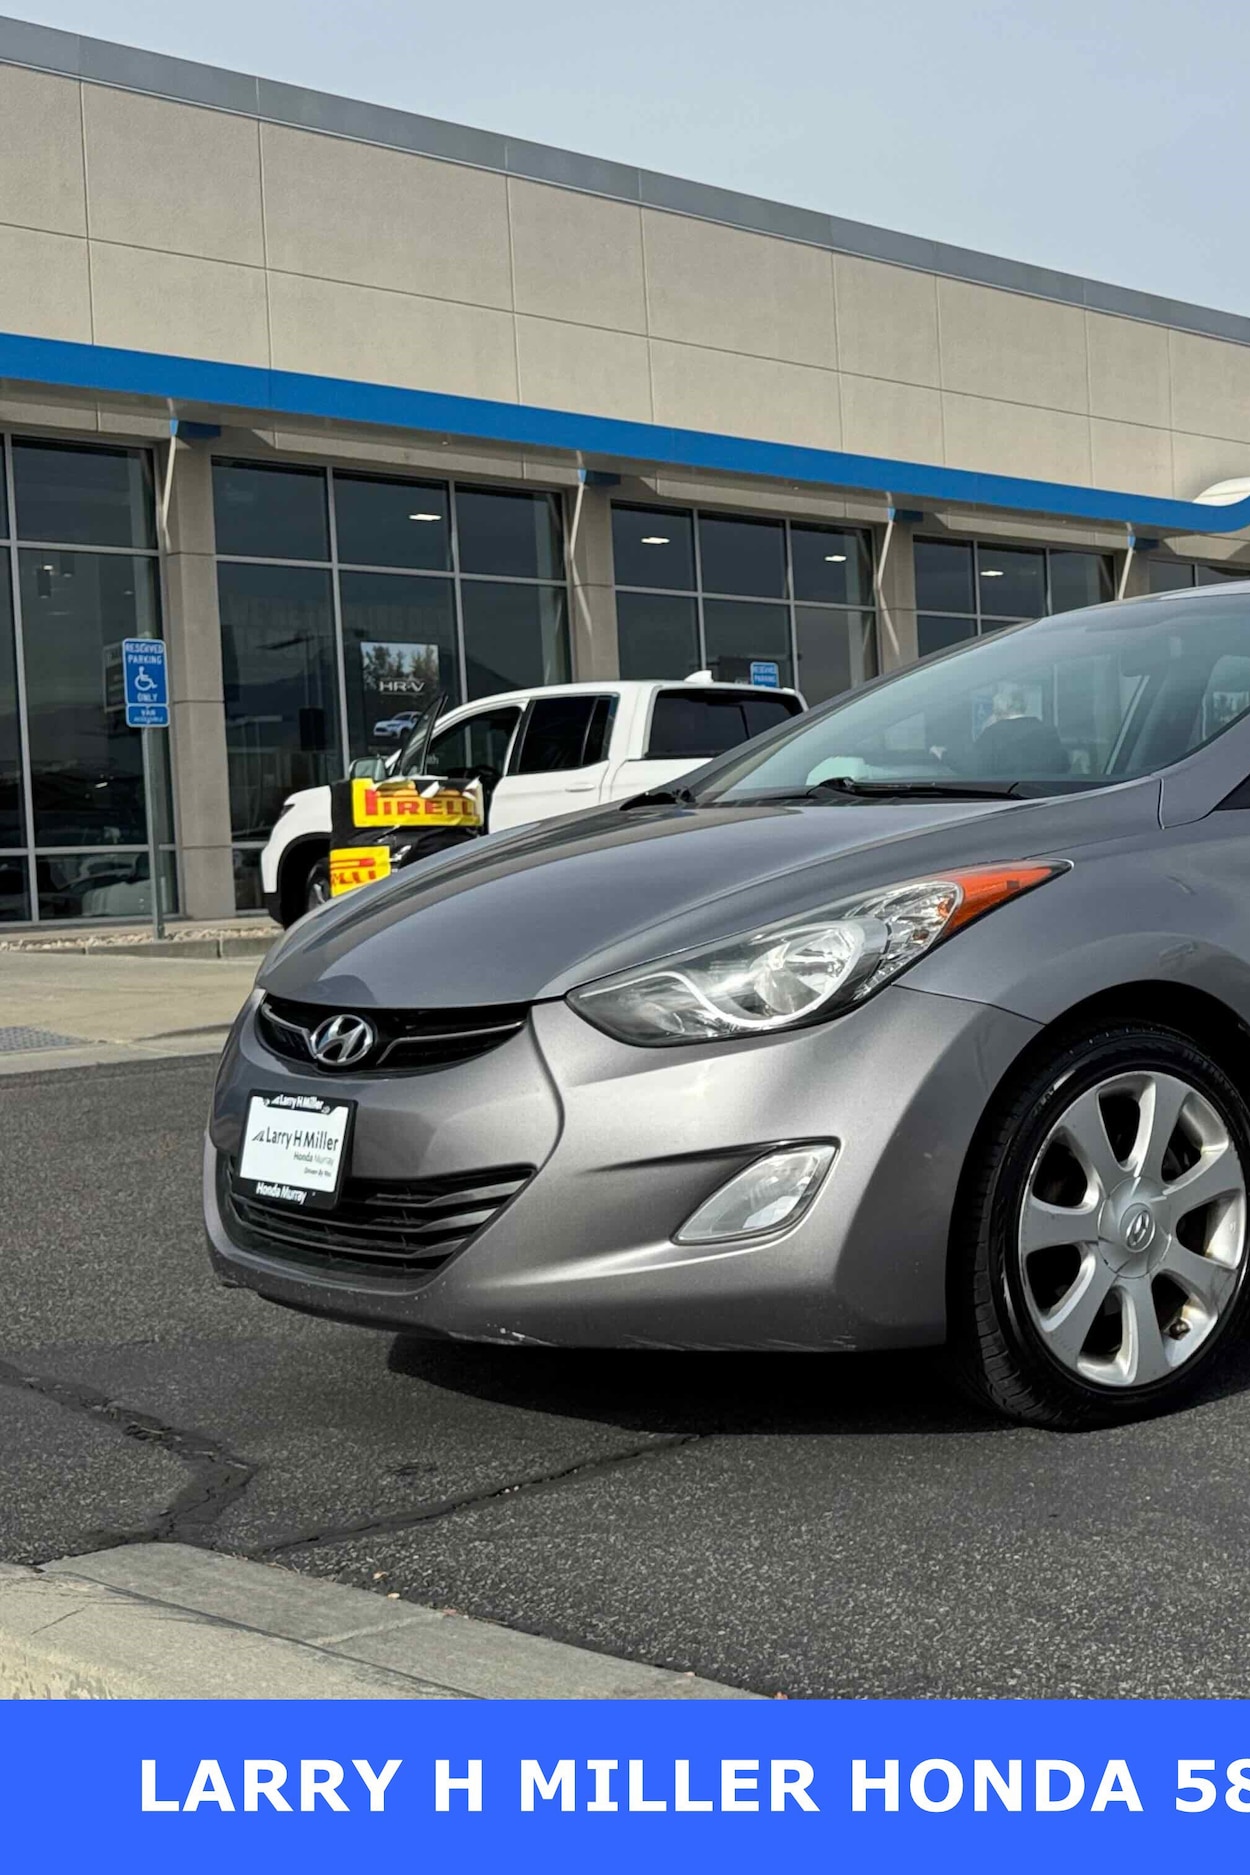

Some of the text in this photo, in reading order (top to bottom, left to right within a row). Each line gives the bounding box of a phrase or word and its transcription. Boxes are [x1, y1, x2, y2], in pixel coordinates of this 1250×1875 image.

[125, 643, 164, 653] RESERVED
[127, 654, 162, 665] PARKING
[379, 681, 425, 693] HR-V
[137, 692, 158, 702] ONLY
[266, 1126, 339, 1152] Larry H Miller
[255, 1181, 281, 1198] Honda
